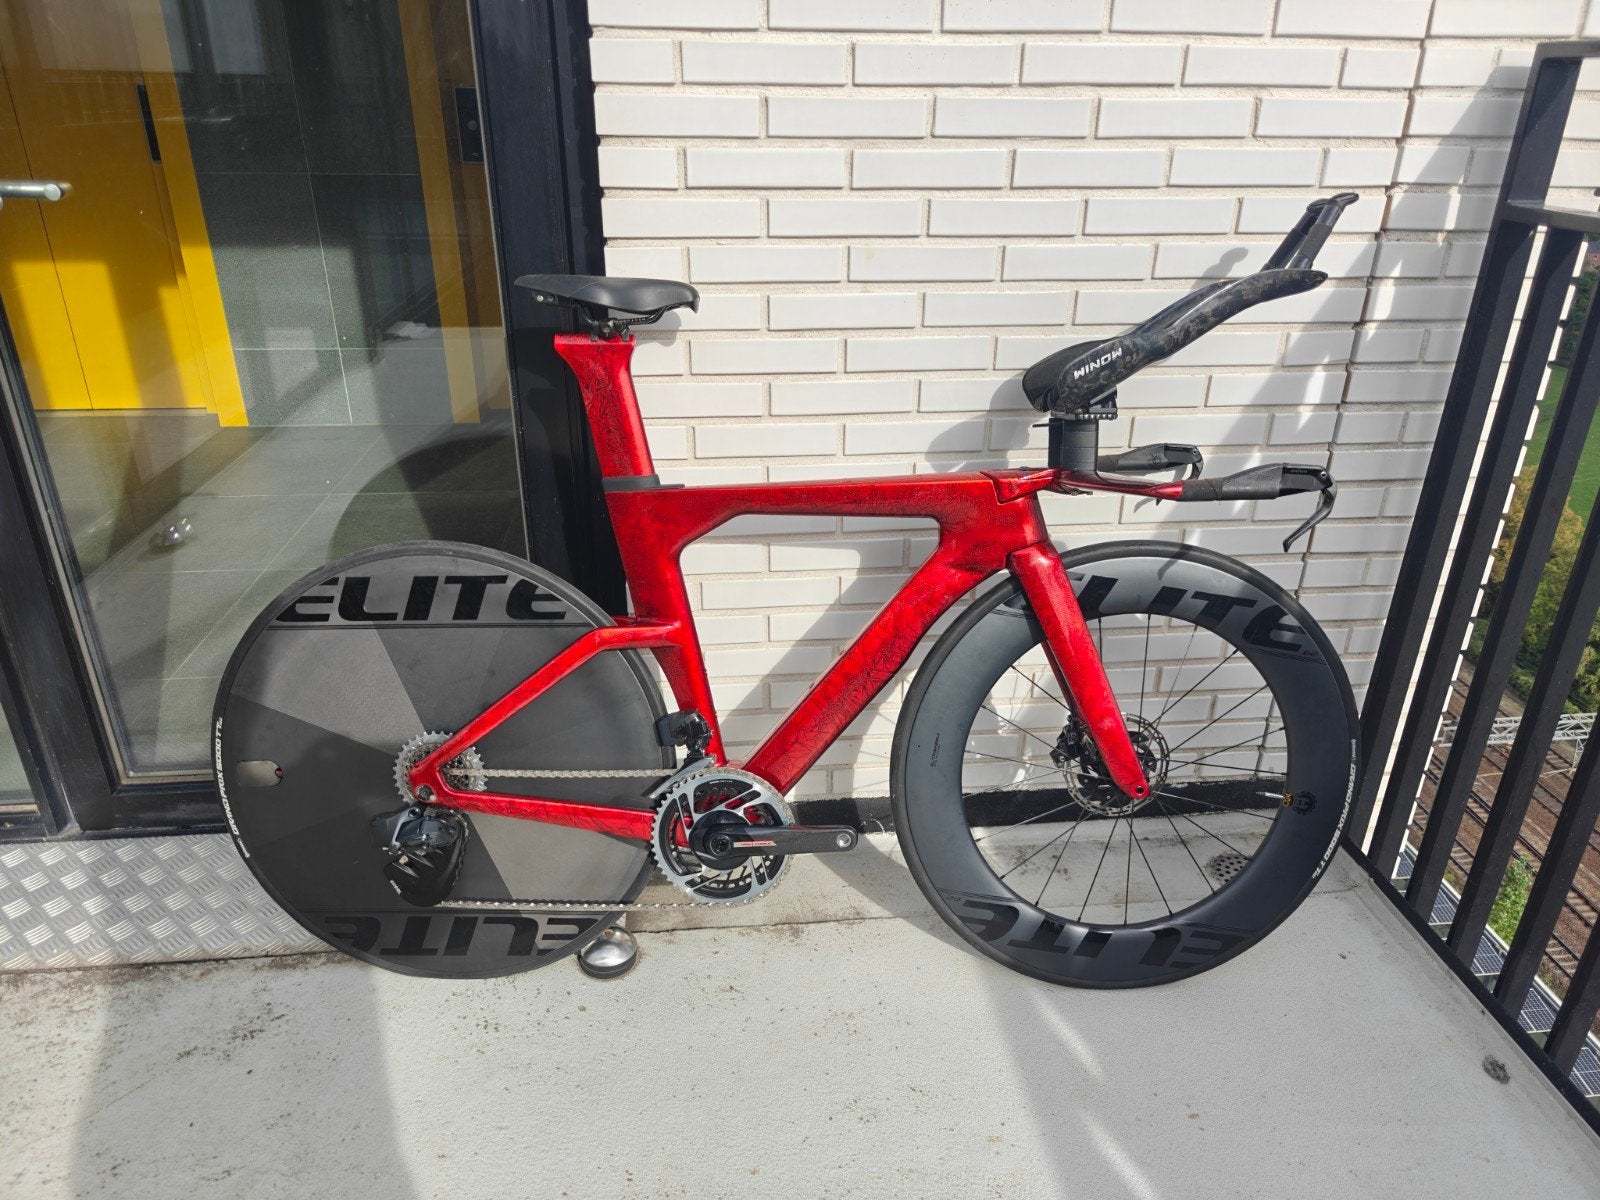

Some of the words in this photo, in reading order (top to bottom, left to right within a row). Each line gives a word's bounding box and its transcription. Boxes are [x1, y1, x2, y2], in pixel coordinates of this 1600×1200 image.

[275, 575, 567, 622] ELITE
[1345, 764, 1357, 803] GRAND
[1338, 801, 1350, 830] PRIX
[1323, 829, 1340, 861] 5000
[324, 916, 600, 956] ELITE
[957, 900, 1245, 968] ELITE
